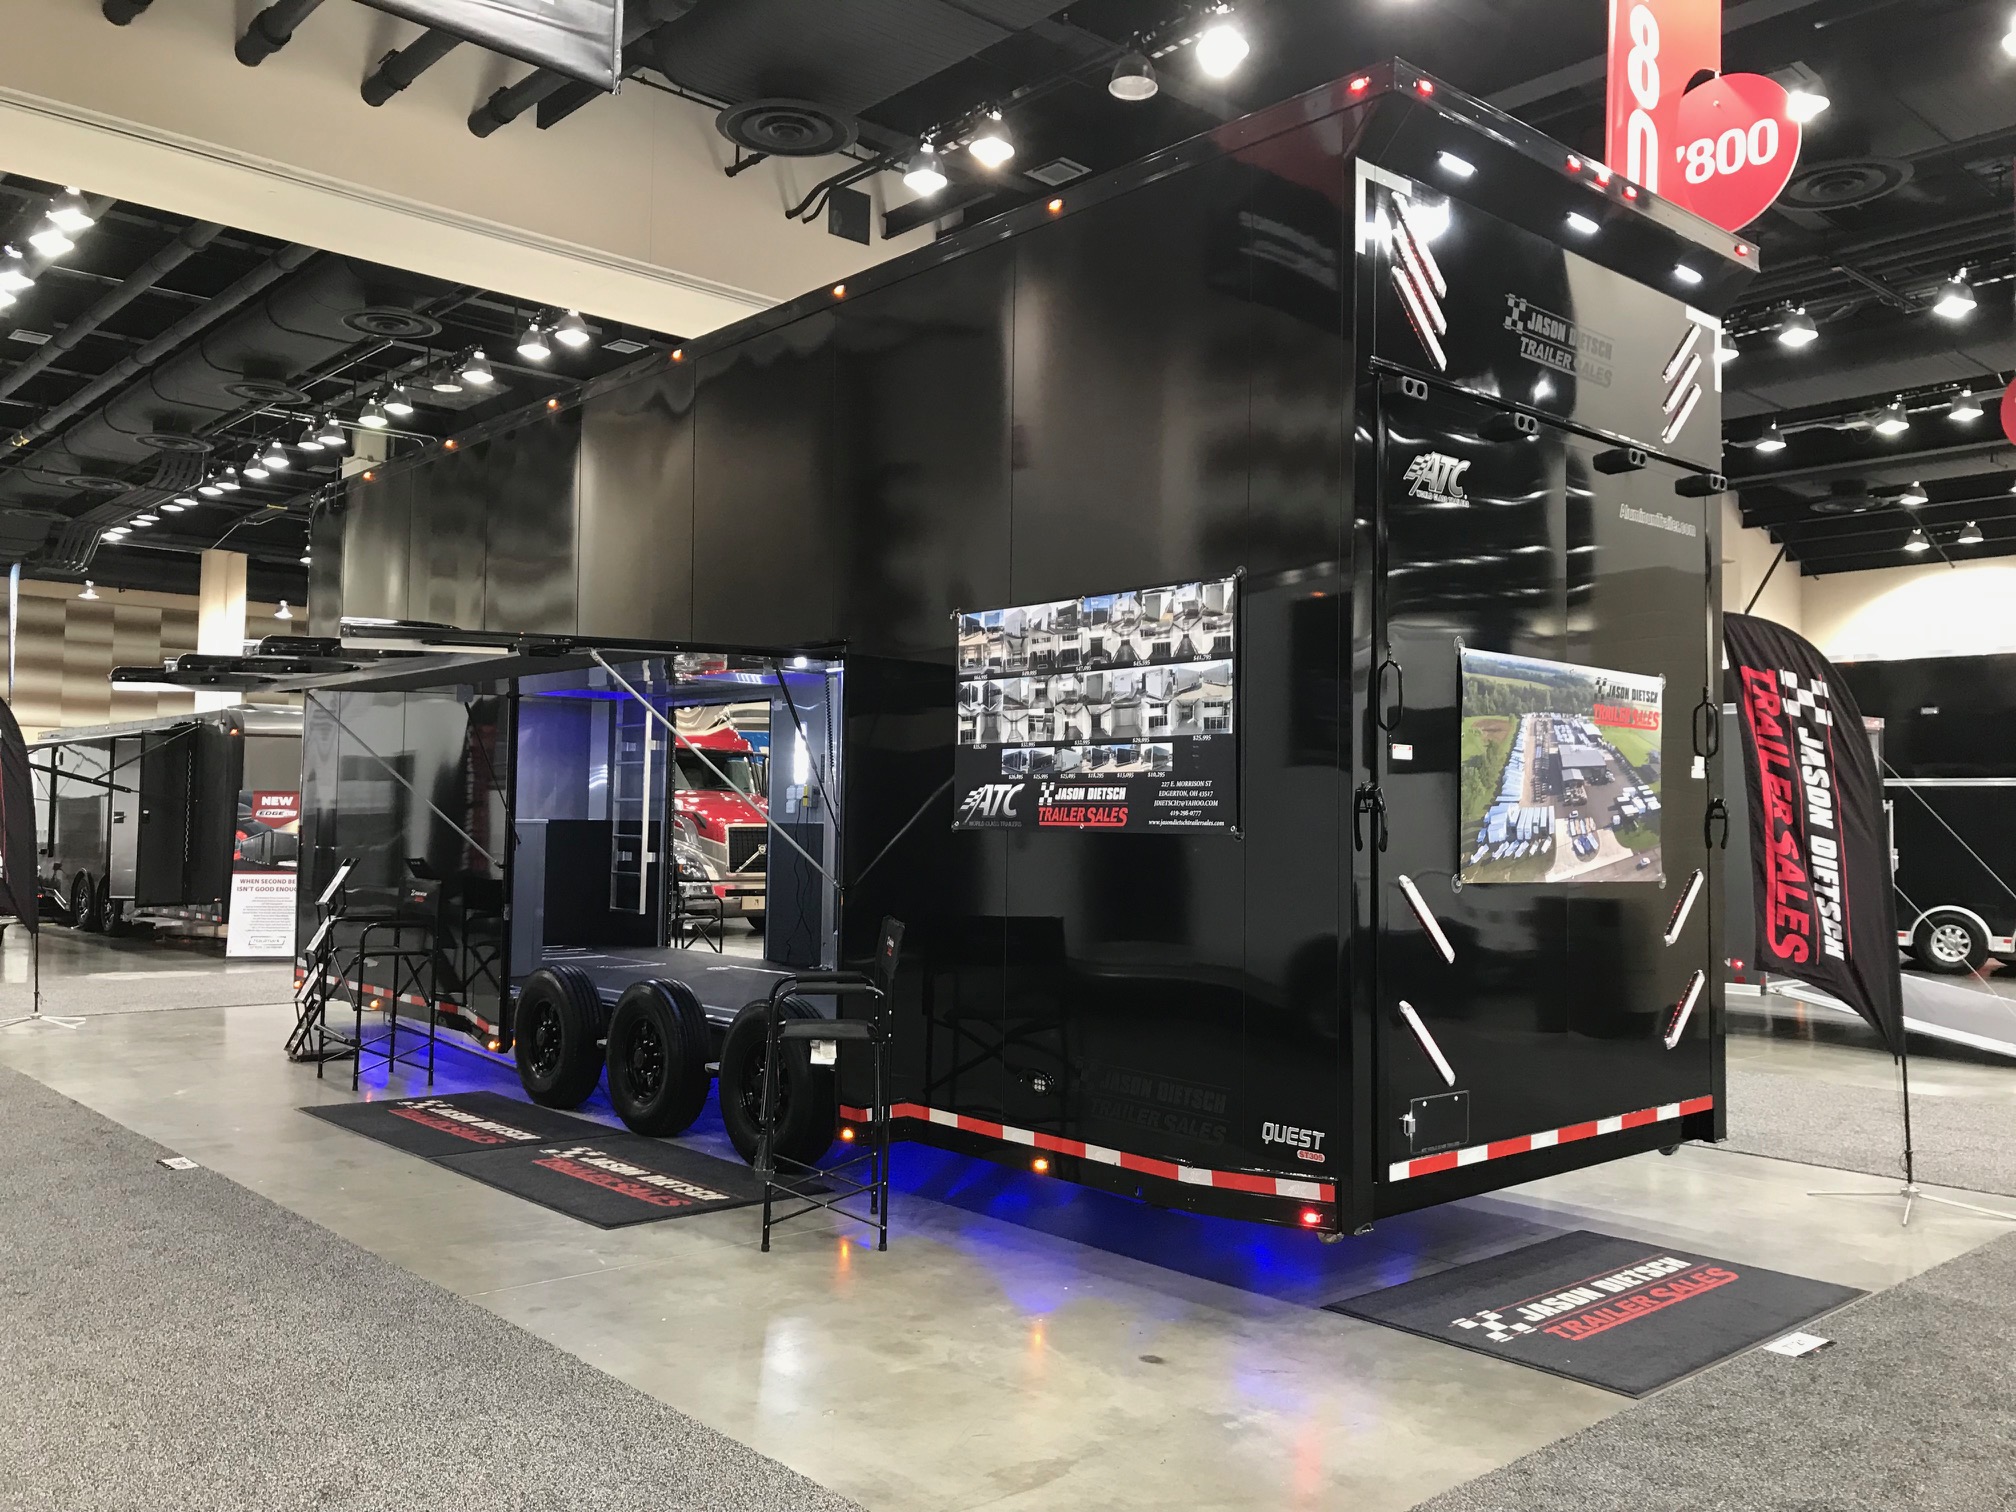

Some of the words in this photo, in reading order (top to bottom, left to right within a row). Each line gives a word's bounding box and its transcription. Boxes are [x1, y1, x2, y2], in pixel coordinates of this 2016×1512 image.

[1520, 336, 1572, 369] TRAILER
[1527, 312, 1566, 342] JASON
[1568, 327, 1613, 360] DETSCH
[1421, 451, 1471, 498] ATC
[1606, 685, 1630, 699] JASON
[1631, 688, 1658, 703] DIETSCH
[1593, 703, 1631, 723] TRAILER
[1633, 708, 1660, 730] SALES
[1746, 666, 1793, 826] TRAILER
[1055, 787, 1085, 801] JASON
[1087, 786, 1127, 801] DIETSCH
[1798, 727, 1834, 829] JASON
[261, 796, 294, 806] NEW
[977, 783, 1026, 817] ATC
[1038, 806, 1086, 823] TRAILER
[1087, 806, 1128, 826] SALES
[1768, 830, 1810, 963] SALES
[1810, 834, 1845, 961] DIETSCH
[1261, 1121, 1326, 1150] QUEST
[1517, 1287, 1606, 1322] JASON
[1590, 1256, 1692, 1293] DIETSCH
[1543, 1294, 1655, 1339] TRAILER
[1650, 1267, 1740, 1306] SALES
